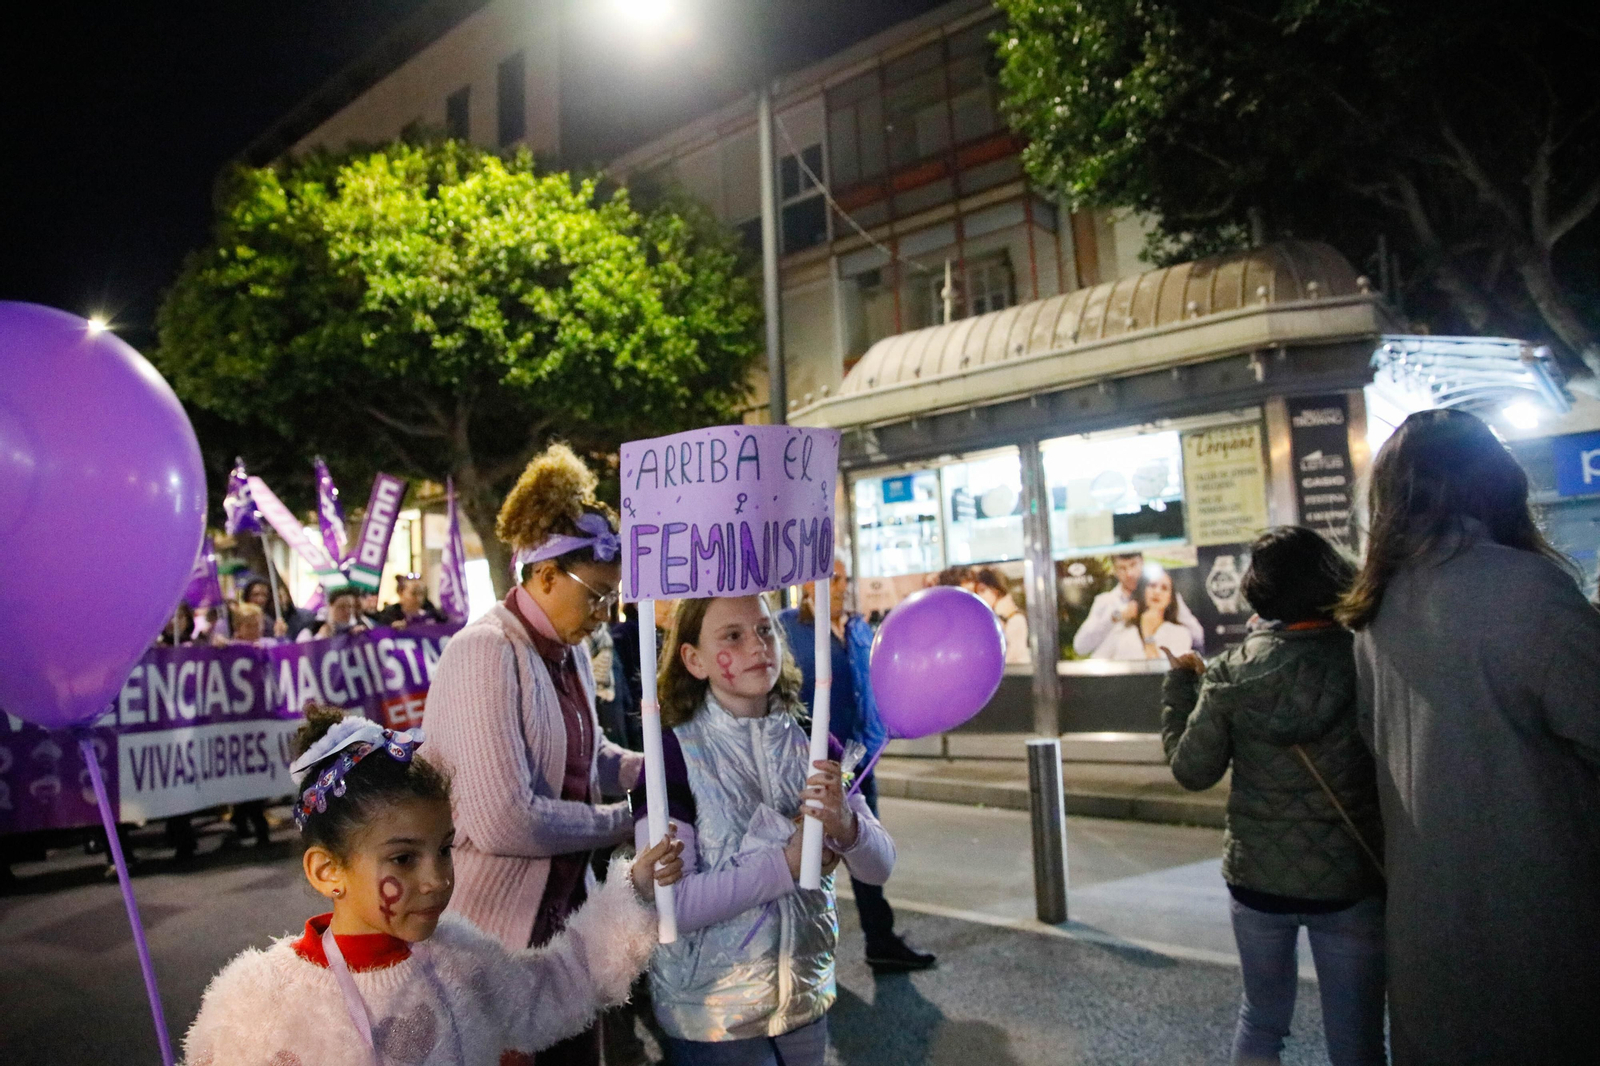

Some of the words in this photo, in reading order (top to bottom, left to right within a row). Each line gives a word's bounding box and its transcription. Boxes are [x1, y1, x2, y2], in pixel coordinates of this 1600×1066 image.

[636, 434, 761, 490] ARRIBA
[630, 516, 832, 599] FEMINISMO
[95, 657, 255, 728] ENCIAS
[264, 636, 450, 714] MACHISTA
